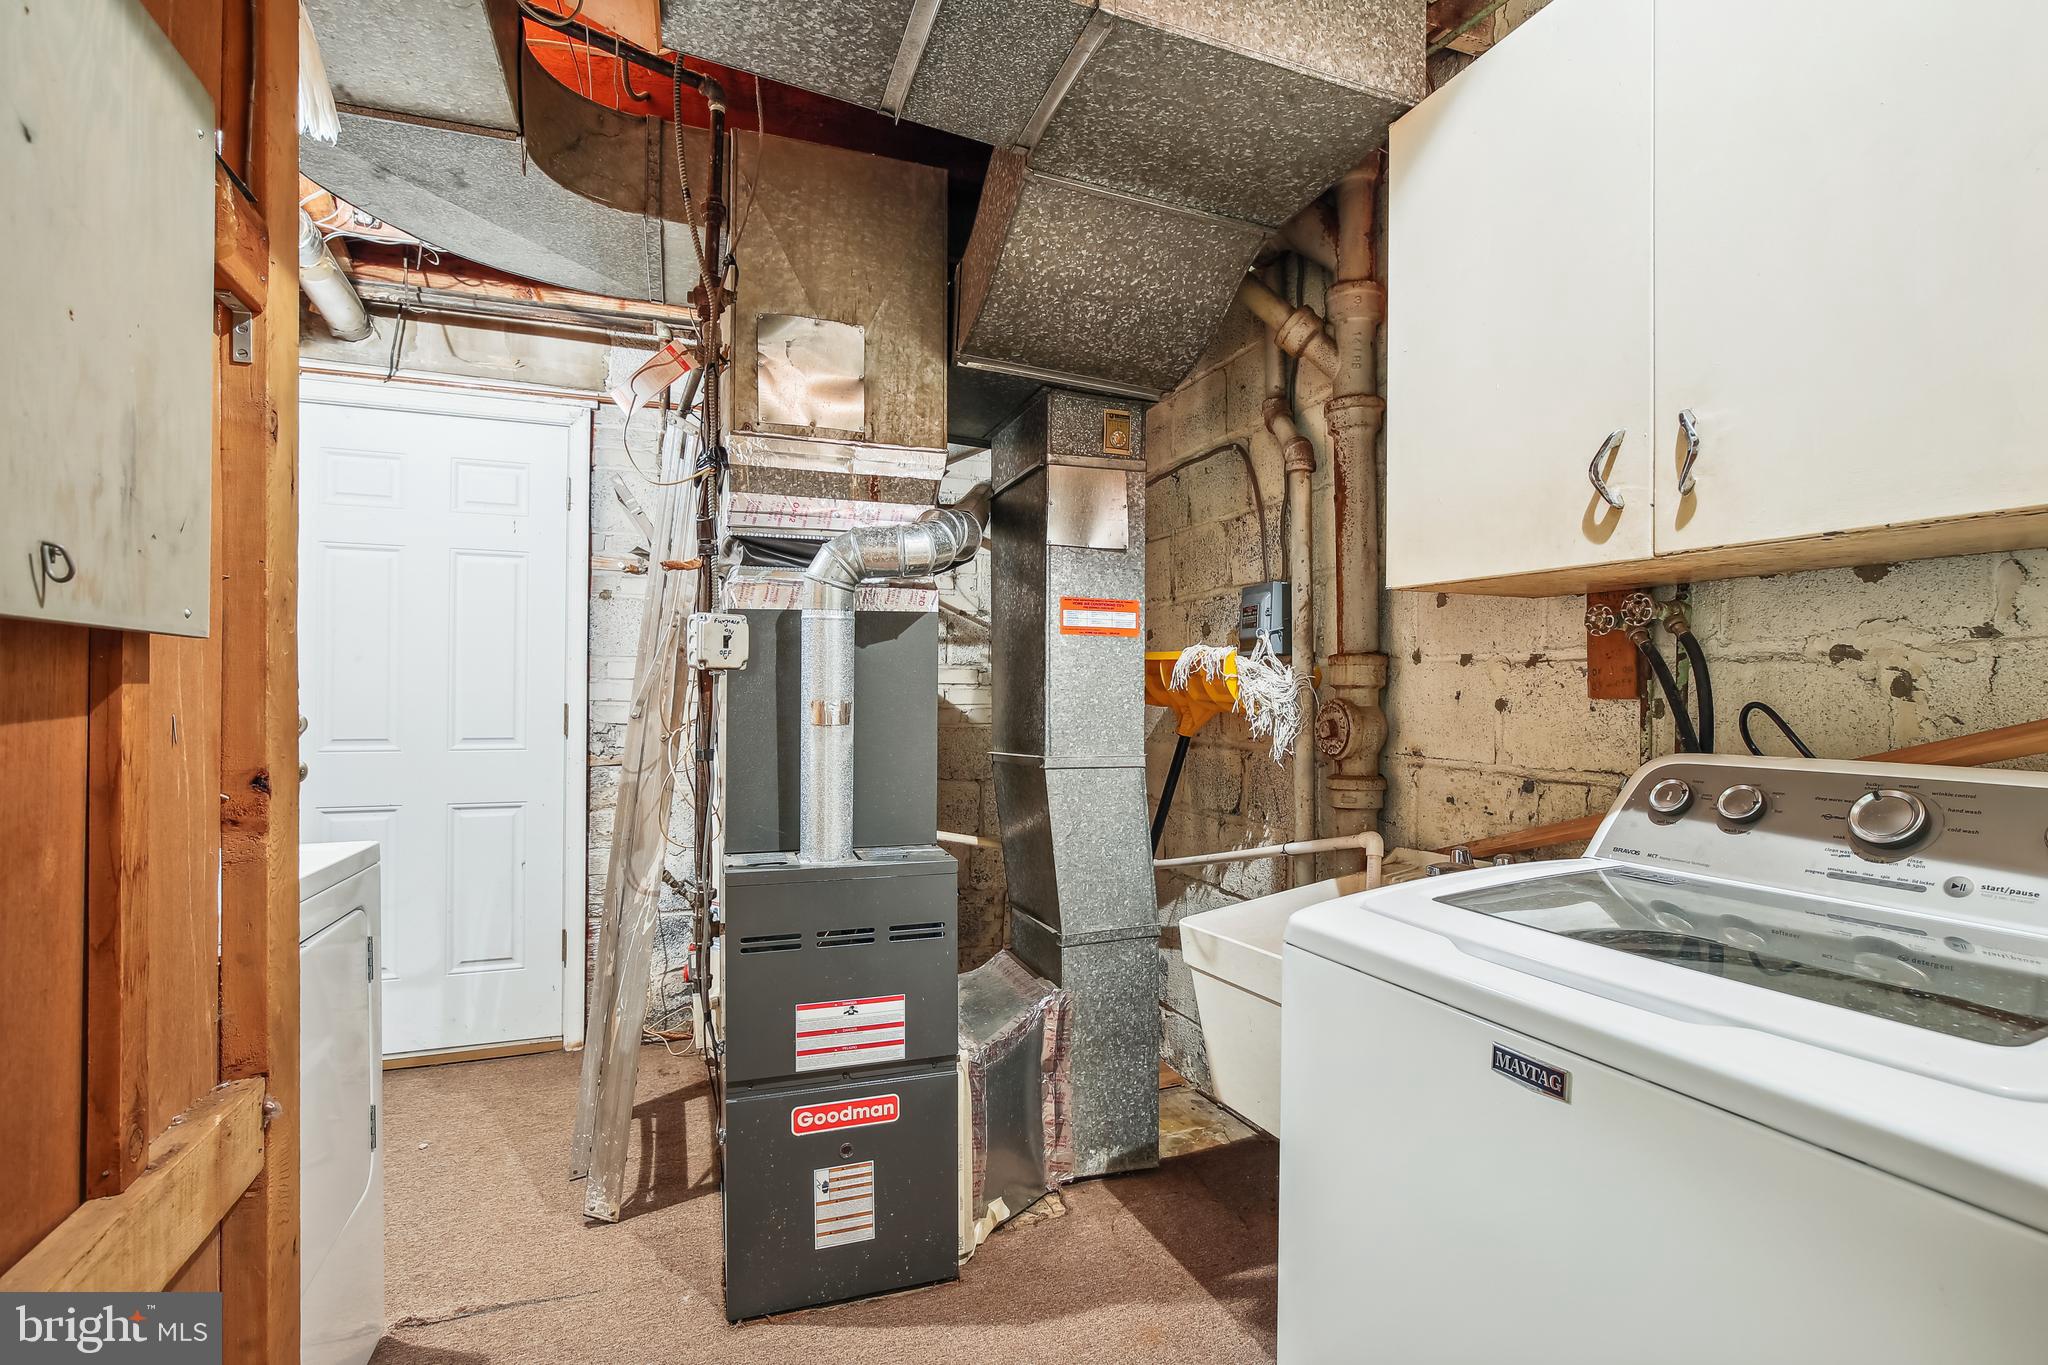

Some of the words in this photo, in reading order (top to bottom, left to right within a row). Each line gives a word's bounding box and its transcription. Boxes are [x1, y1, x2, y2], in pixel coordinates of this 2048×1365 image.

[1612, 846, 1641, 856] BRAVOS
[1980, 884, 2040, 898] start/pause
[1771, 929, 1800, 939] softener
[1911, 958, 1954, 972] detergent
[1495, 1050, 1562, 1092] MAYTAG
[797, 1103, 895, 1127] Goodman
